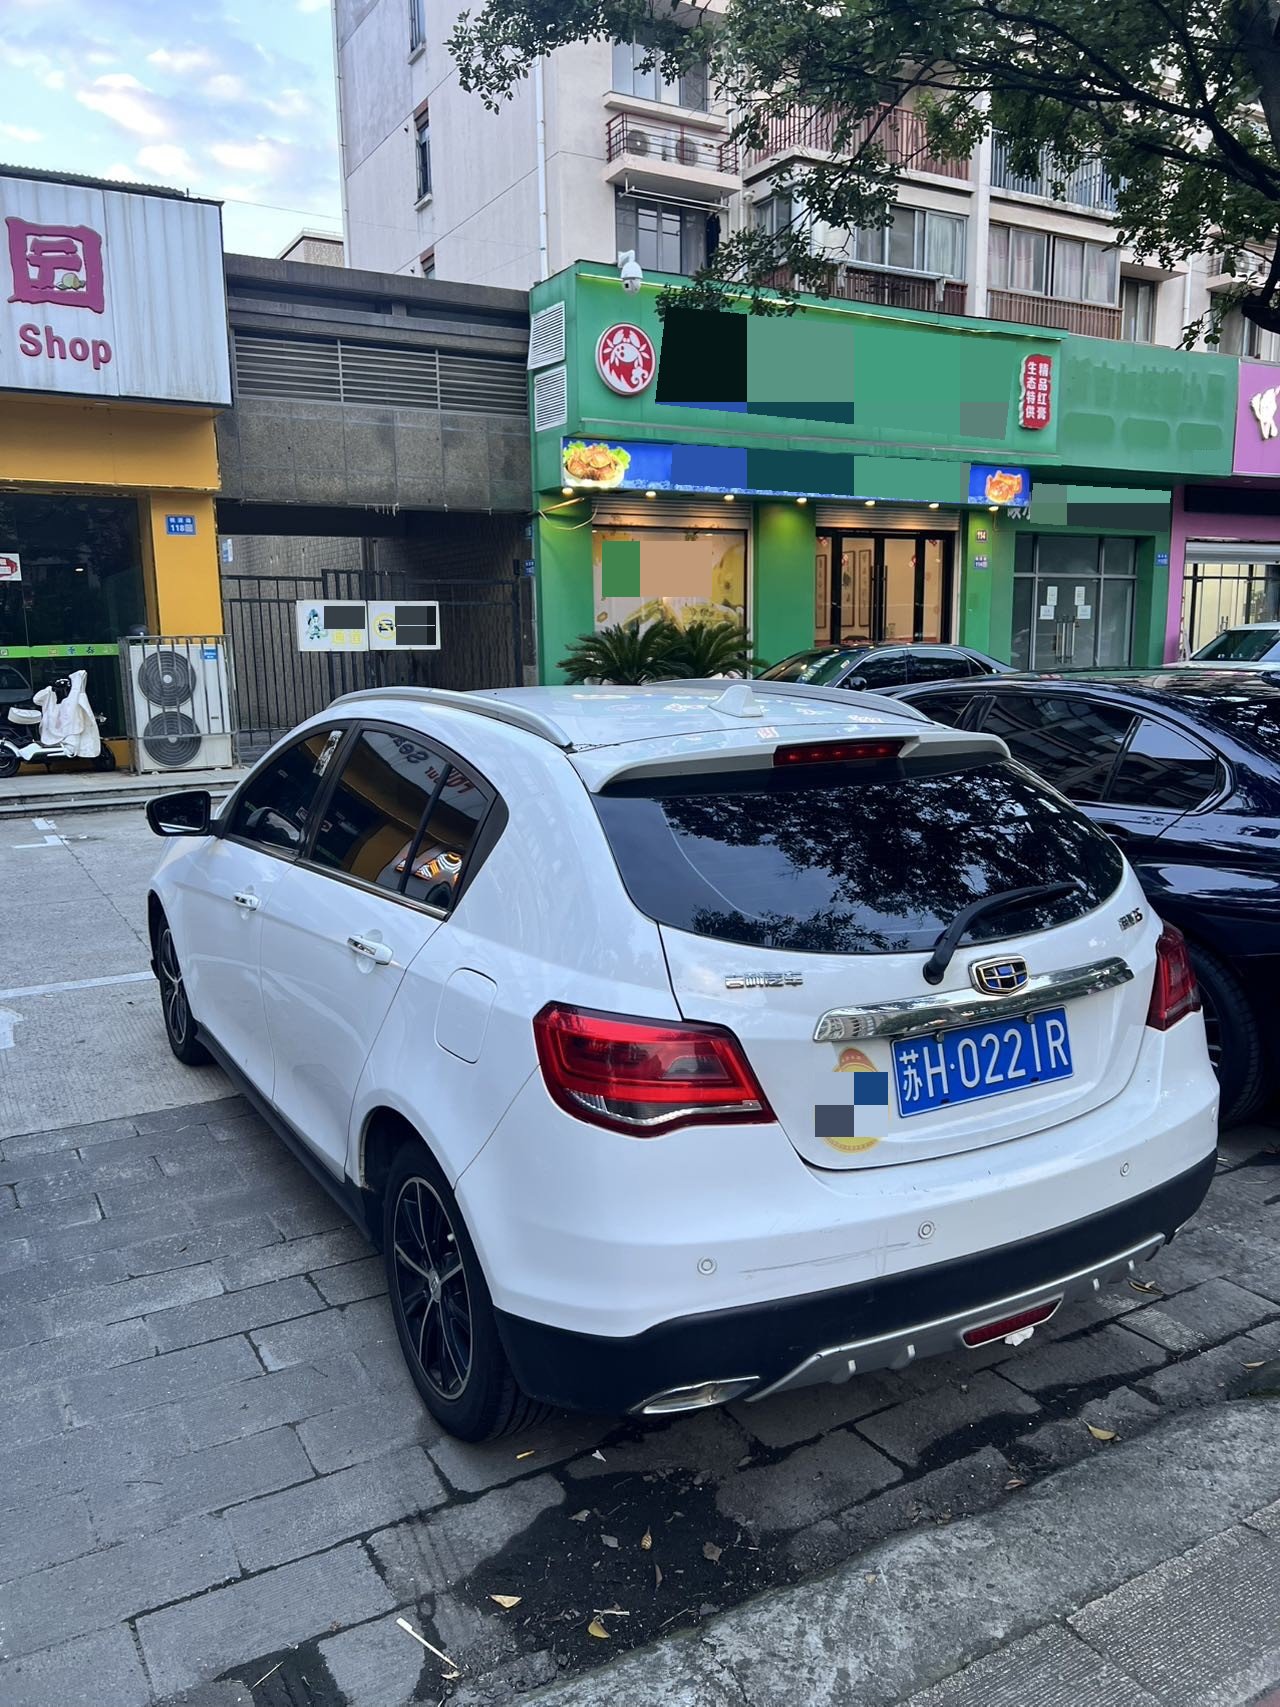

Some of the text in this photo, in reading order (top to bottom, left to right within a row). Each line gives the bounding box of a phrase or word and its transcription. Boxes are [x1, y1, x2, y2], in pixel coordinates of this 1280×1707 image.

[19, 322, 112, 370] Shop
[1025, 361, 1037, 419] 生态特供
[1036, 362, 1049, 420] 精品红膏
[899, 1019, 1069, 1102] 苏H·0221R
